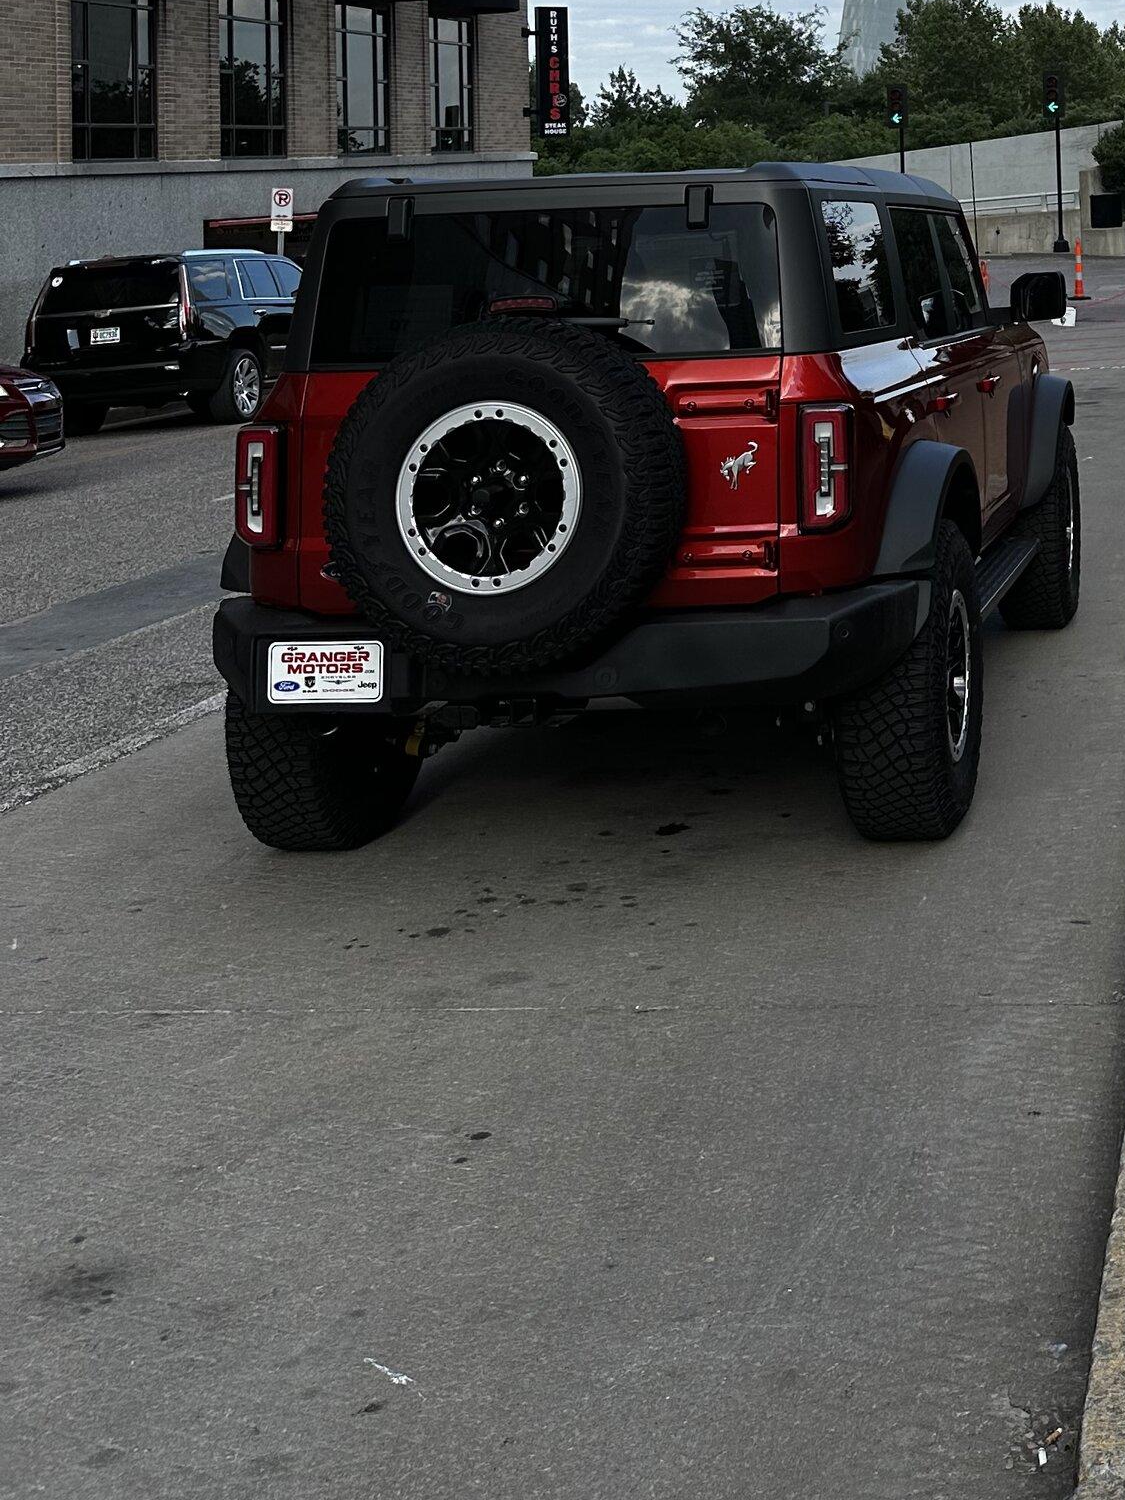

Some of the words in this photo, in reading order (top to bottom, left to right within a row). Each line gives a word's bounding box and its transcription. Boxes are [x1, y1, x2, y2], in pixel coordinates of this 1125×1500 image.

[281, 651, 370, 663] GRANGER
[287, 663, 364, 674] MOTORS
[278, 681, 296, 691] Ford
[357, 681, 378, 690] Jeep
